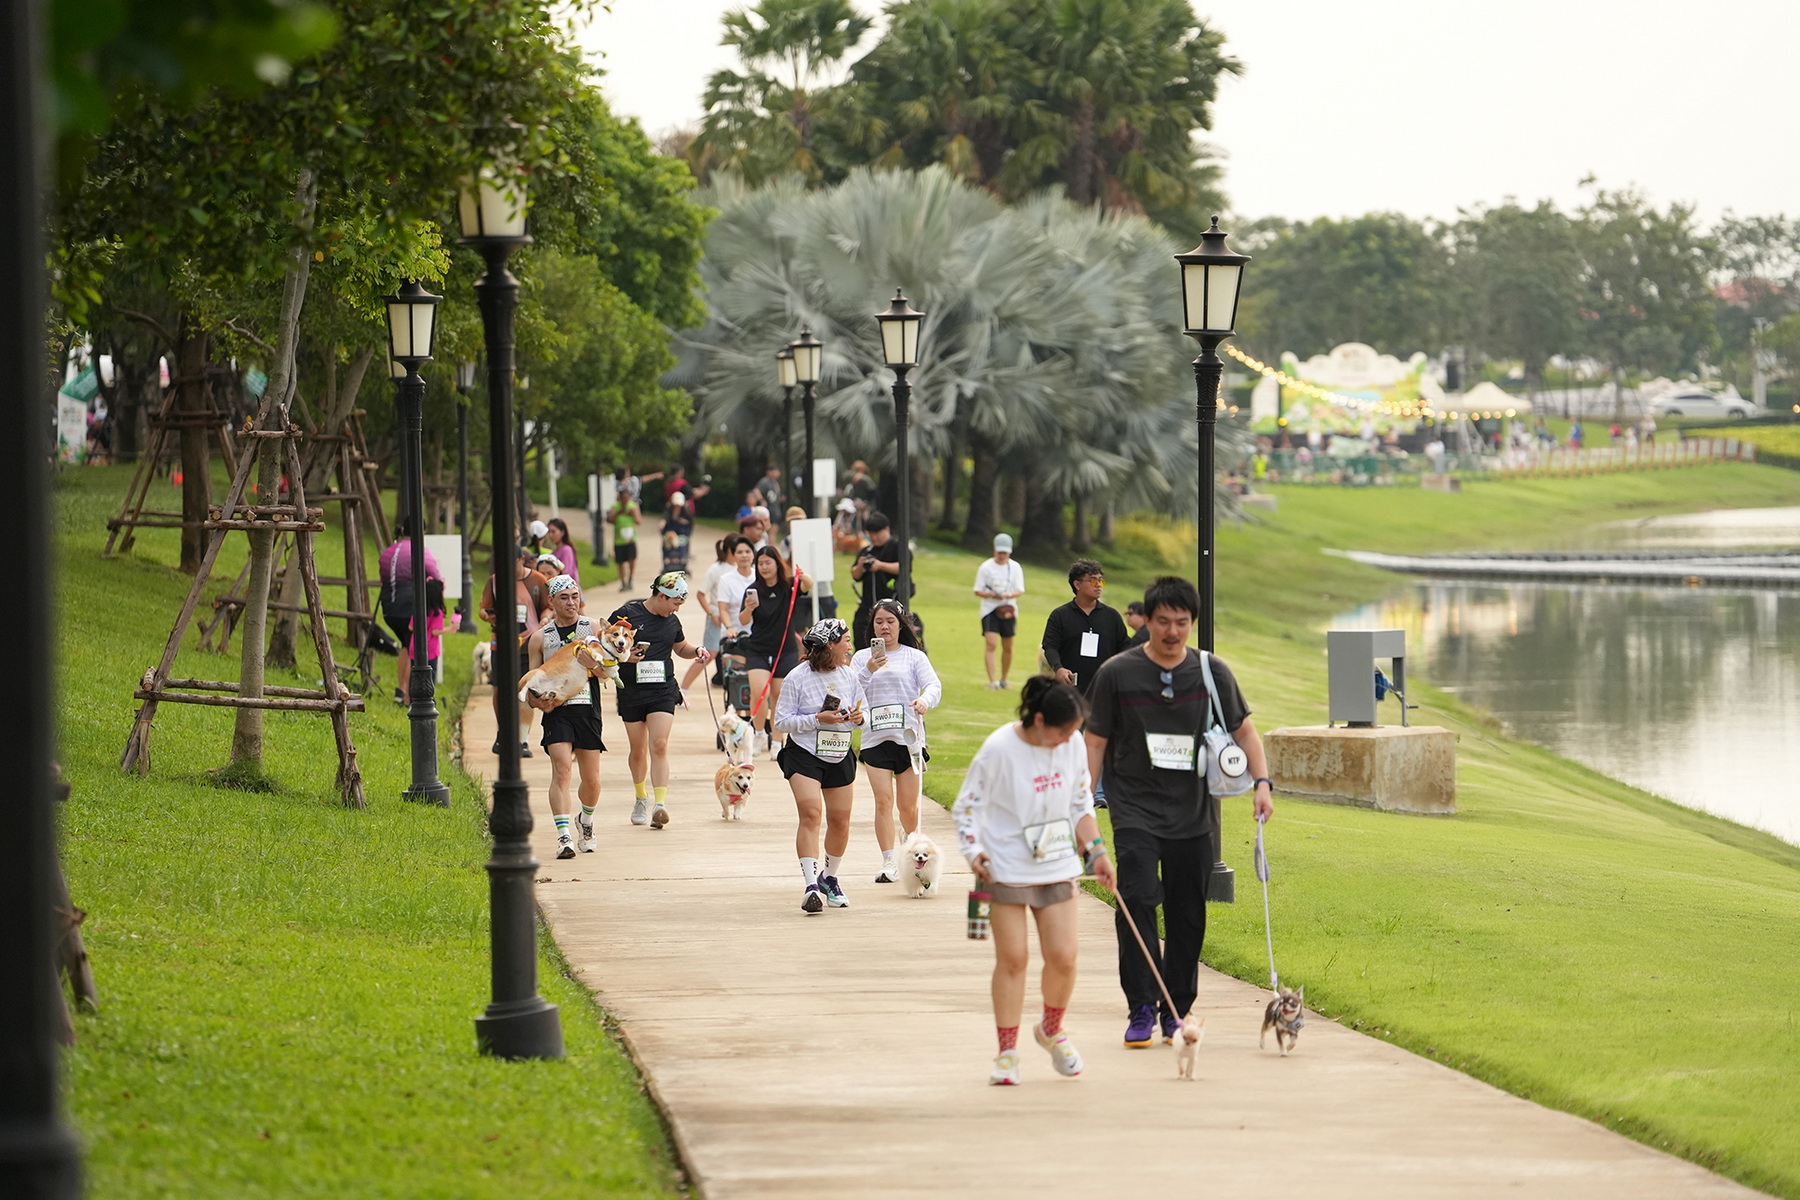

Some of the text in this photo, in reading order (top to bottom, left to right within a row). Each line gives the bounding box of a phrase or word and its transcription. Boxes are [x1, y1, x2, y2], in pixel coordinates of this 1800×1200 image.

[874, 712, 900, 721] RW0378
[821, 739, 849, 748] RW0377
[1153, 746, 1188, 756] RW0047
